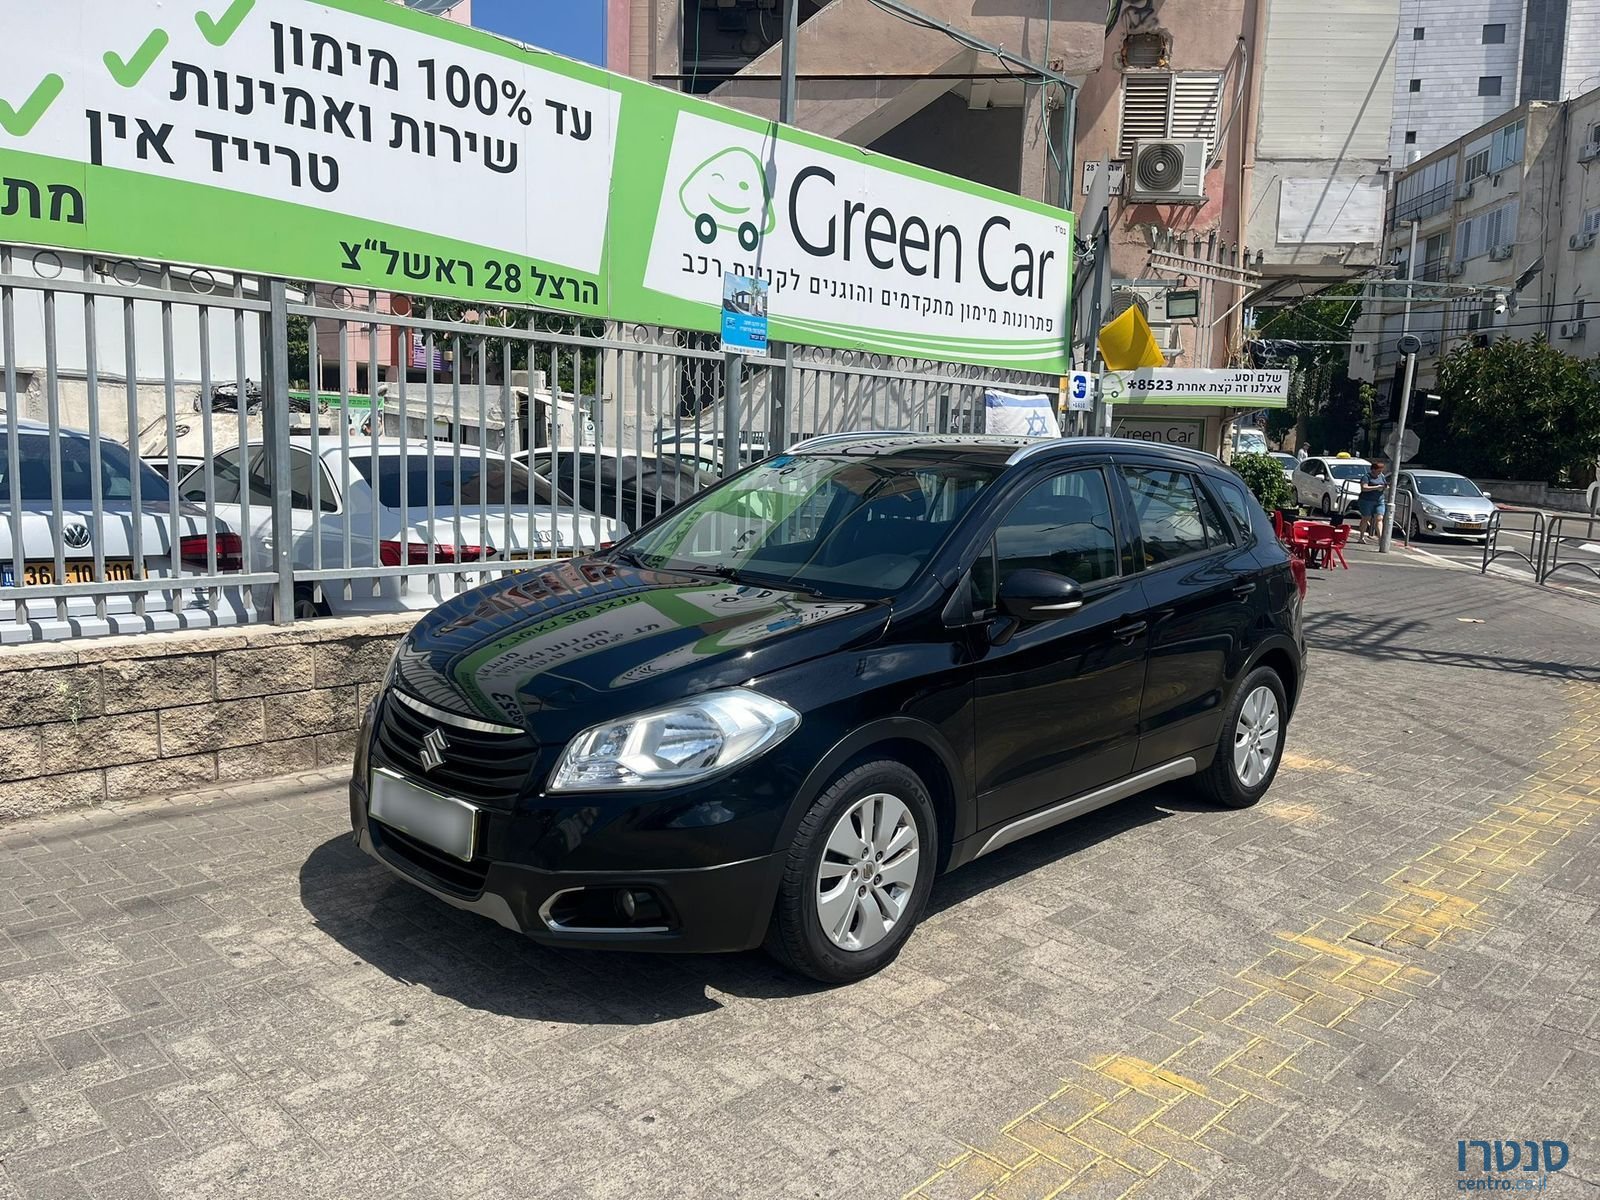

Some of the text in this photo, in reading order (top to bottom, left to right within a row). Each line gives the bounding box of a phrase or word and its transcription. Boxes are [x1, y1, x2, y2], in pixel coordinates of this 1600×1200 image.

[270, 21, 592, 142] עד 100% מימון
[169, 60, 518, 174] שירות ואמינות
[86, 109, 340, 193] טרייד אין
[788, 165, 1054, 300] Green Car
[484, 260, 522, 294] 28
[682, 253, 722, 278] רכב
[530, 266, 599, 305] הרצל
[809, 276, 873, 303] והוגנים
[881, 289, 953, 317] מתקדמים
[960, 303, 996, 323] מימון
[1002, 310, 1054, 332] פתרונות
[1177, 383, 1281, 394] אצלנו זה קצת אחרת
[1258, 373, 1282, 383] שלם
[1166, 427, 1195, 443] Car
